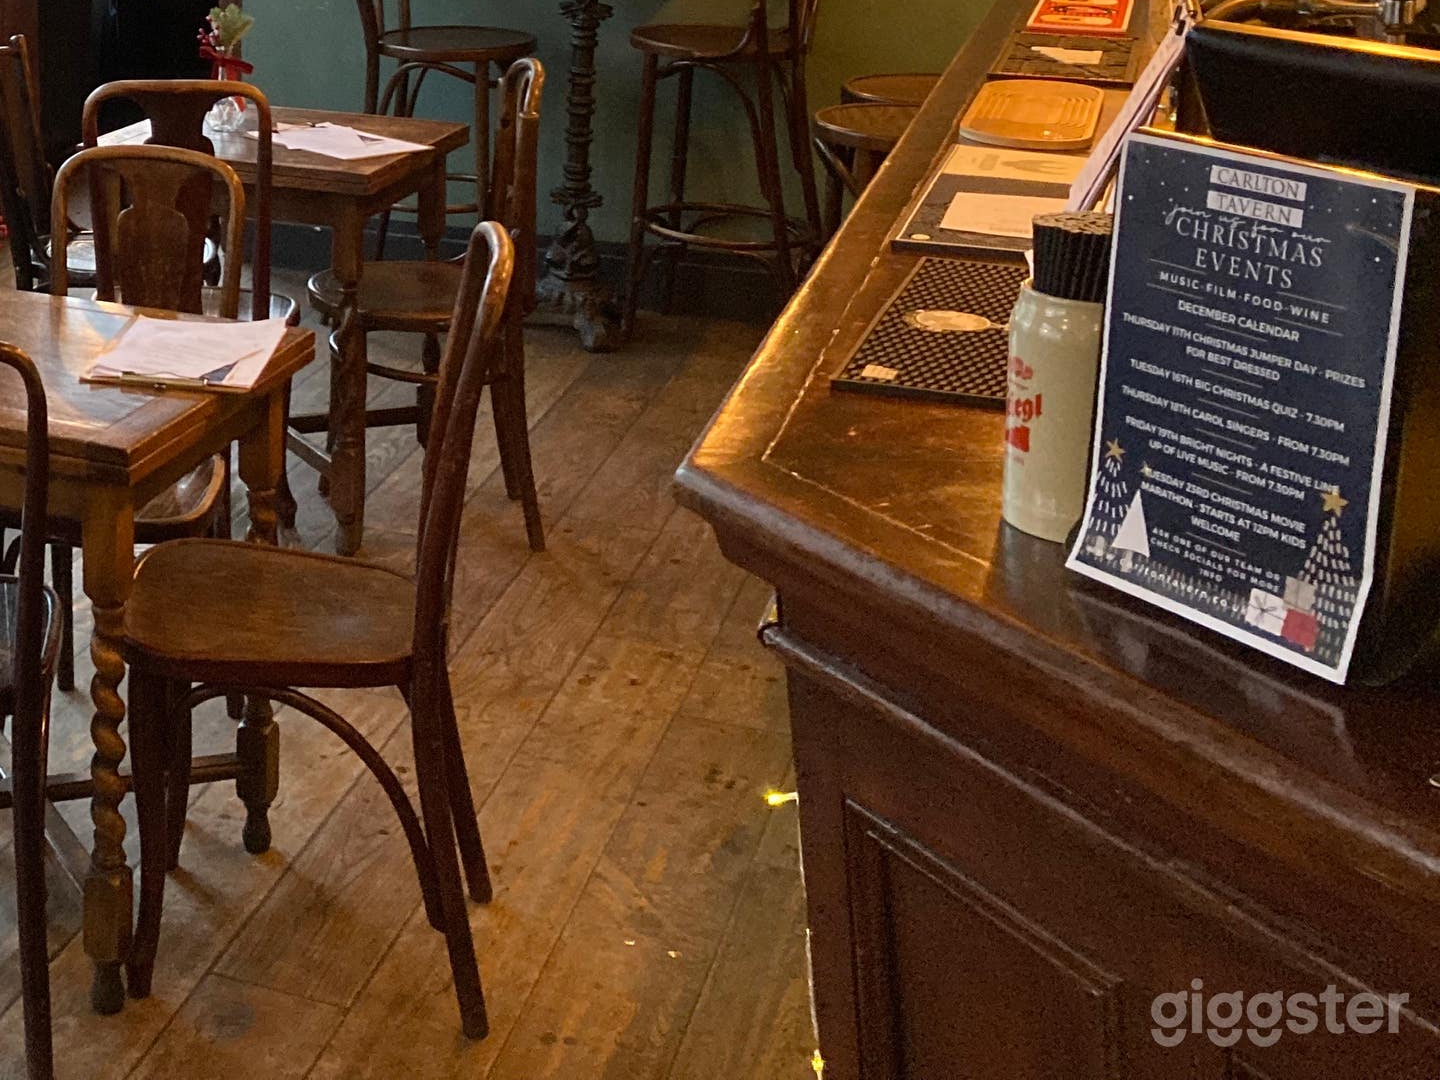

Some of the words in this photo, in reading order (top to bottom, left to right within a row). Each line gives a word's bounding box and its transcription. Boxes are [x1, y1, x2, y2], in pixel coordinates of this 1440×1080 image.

[1217, 194, 1293, 225] TAVERN
[1218, 169, 1299, 199] CARLTON
[1176, 216, 1323, 267] CHRISTMAS
[1195, 248, 1293, 289] EVENTS
[1160, 271, 1200, 290] MUSIC
[1206, 283, 1237, 299] FILM
[1244, 293, 1283, 311] FOOD
[1290, 305, 1331, 323] WINE
[1178, 300, 1236, 324] DECEMBER
[1237, 317, 1300, 342] CALENDAR
[1123, 312, 1171, 335] THURSDAY
[1192, 333, 1249, 356] CHRISTMAS
[1250, 349, 1292, 368] JUMPER
[1294, 360, 1317, 375] DAY
[1325, 369, 1366, 388] PRIZES
[1186, 346, 1206, 359] FOR
[1207, 352, 1232, 367] BEST
[1233, 359, 1280, 381] DRESSED
[1131, 358, 1171, 379] TUESDAY
[1172, 372, 1193, 386] 16TH
[1212, 385, 1270, 410] CHRISTMAS
[1271, 402, 1298, 419] QUIZ
[1306, 412, 1344, 432] 7.30PM
[1122, 384, 1169, 407] THURSDAY
[1192, 409, 1224, 428] CAROL
[1226, 420, 1270, 441] SINGERS
[1278, 436, 1309, 454] FROM
[1311, 446, 1350, 467] 7.30PM
[1126, 415, 1157, 434] FRIDAY
[1179, 435, 1215, 454] BRIGHT
[1216, 447, 1253, 467] NIGHTS
[1260, 462, 1268, 472] A
[1270, 465, 1312, 487] FESTIVE
[1149, 439, 1162, 450] UP
[1163, 445, 1176, 456] OF
[1177, 450, 1196, 464] LIVE
[1197, 457, 1229, 475] MUSIC
[1236, 470, 1266, 488] FROM
[1267, 480, 1305, 500] 7.30PM
[1141, 481, 1193, 508] MARATHON
[1199, 503, 1236, 525] STARTS
[1237, 517, 1251, 530] AT
[1252, 522, 1279, 540] 12PM
[1281, 532, 1306, 549] KIDS
[1148, 471, 1185, 489] UESDAY
[1185, 482, 1209, 499] 23RD
[1210, 492, 1269, 520] CHRISTMAS
[1270, 513, 1306, 534] MOVIE
[1191, 515, 1241, 542] WELCOME
[1150, 537, 1181, 554] CHECK
[1183, 551, 1223, 572] SOCIALS
[1226, 567, 1247, 580] FOR
[1250, 576, 1280, 593] MORE
[1152, 527, 1170, 539] ASK
[1172, 535, 1192, 548] ONE
[1194, 543, 1208, 553] OF
[1210, 550, 1231, 564] OUR
[1235, 559, 1262, 575] TEAM
[1265, 571, 1280, 582] OR
